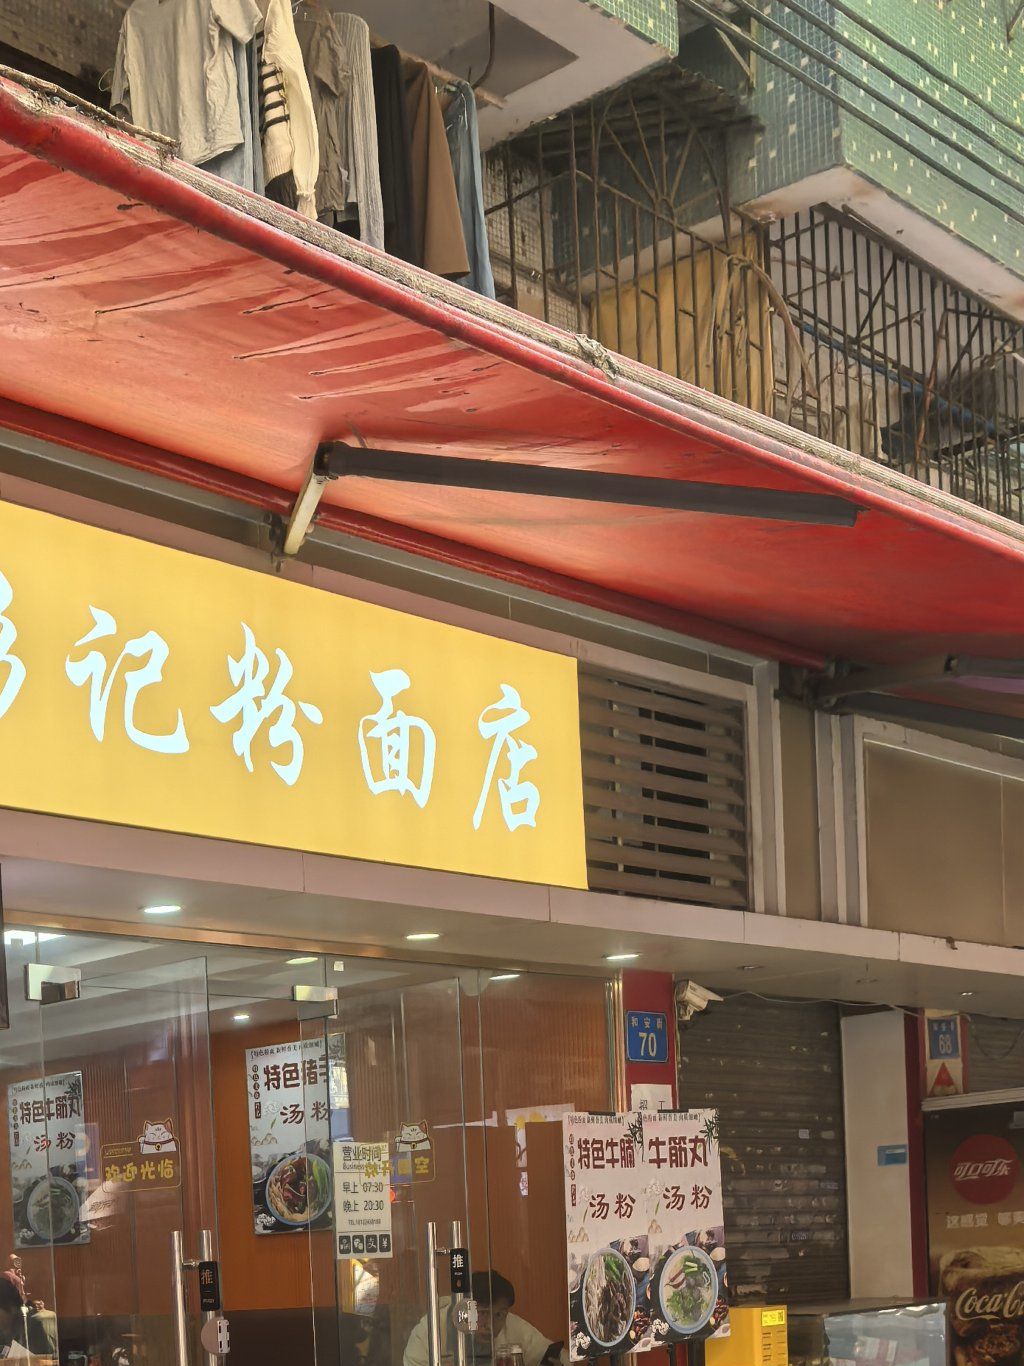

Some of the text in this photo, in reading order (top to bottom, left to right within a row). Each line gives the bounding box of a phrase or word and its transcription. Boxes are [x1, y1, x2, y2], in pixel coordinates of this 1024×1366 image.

[639, 1032, 657, 1057] 70
[33, 1131, 76, 1152] 汤粉
[577, 1137, 636, 1169] 特色牛腩
[648, 1135, 709, 1169] 牛筋丸
[342, 1145, 382, 1162] 营业时间
[105, 1158, 175, 1183] 欢迎光临
[342, 1181, 359, 1194] 早上
[663, 1184, 713, 1211] 汤粉
[343, 1200, 384, 1212] 晚上 20:30
[589, 1193, 636, 1220] 汤粉
[452, 1254, 464, 1268] 推
[201, 1269, 214, 1285] 推
